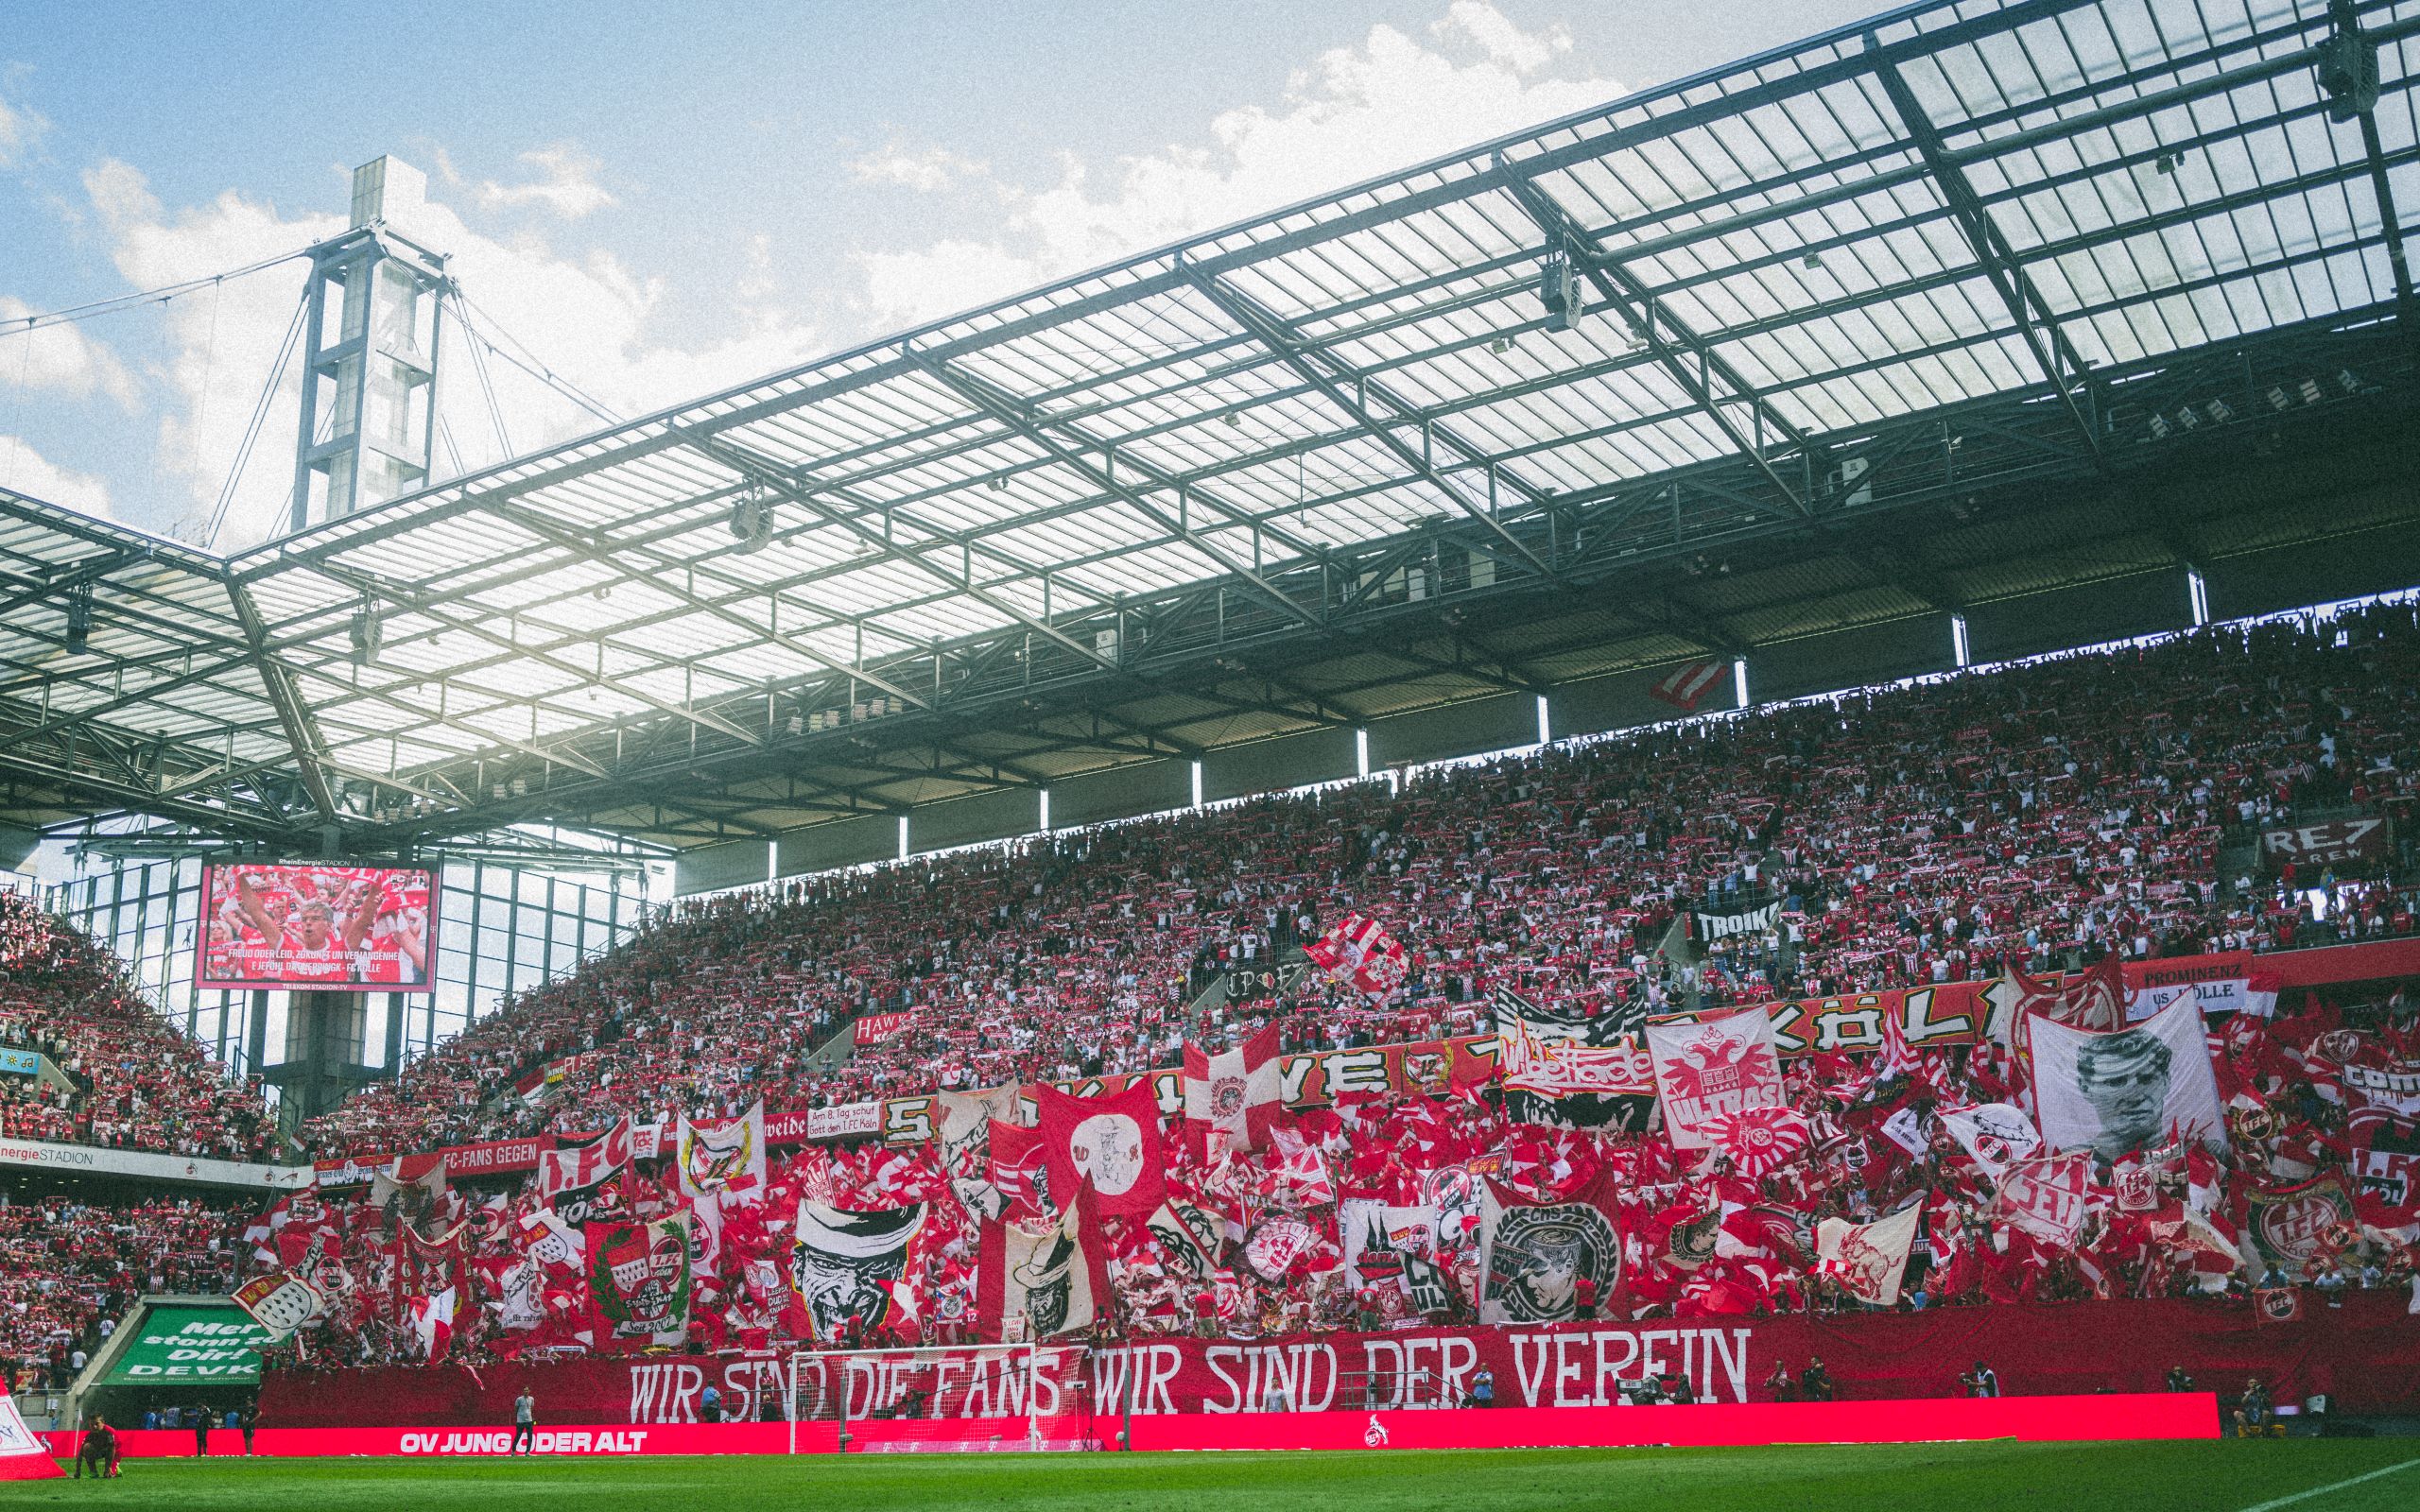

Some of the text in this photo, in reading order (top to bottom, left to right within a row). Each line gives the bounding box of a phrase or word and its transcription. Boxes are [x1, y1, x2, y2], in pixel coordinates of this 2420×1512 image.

[2266, 818, 2382, 853] RE7
[2144, 964, 2242, 986] PROMINENZ
[836, 1109, 850, 1119] Tag
[853, 1106, 875, 1116] schuf
[1669, 1084, 1780, 1125] ULTRAS
[809, 1125, 825, 1135] Gott
[827, 1124, 841, 1133] den
[859, 1117, 877, 1129] Köln
[443, 1143, 537, 1170] FC-FANS GEGEN
[181, 1322, 261, 1335] Mer
[628, 1315, 671, 1332] Seit 2007
[144, 1335, 240, 1346] stonn
[167, 1349, 250, 1361] Dir!
[129, 1365, 258, 1376] DEVK
[630, 1365, 703, 1423] WIR
[723, 1361, 827, 1423] SIND
[846, 1359, 917, 1421] DIE
[1203, 1343, 1338, 1415] SIND
[1364, 1336, 1478, 1411] DER
[1510, 1328, 1752, 1408] VEREIN
[400, 1431, 648, 1453] OV JUNG ODER ALT
